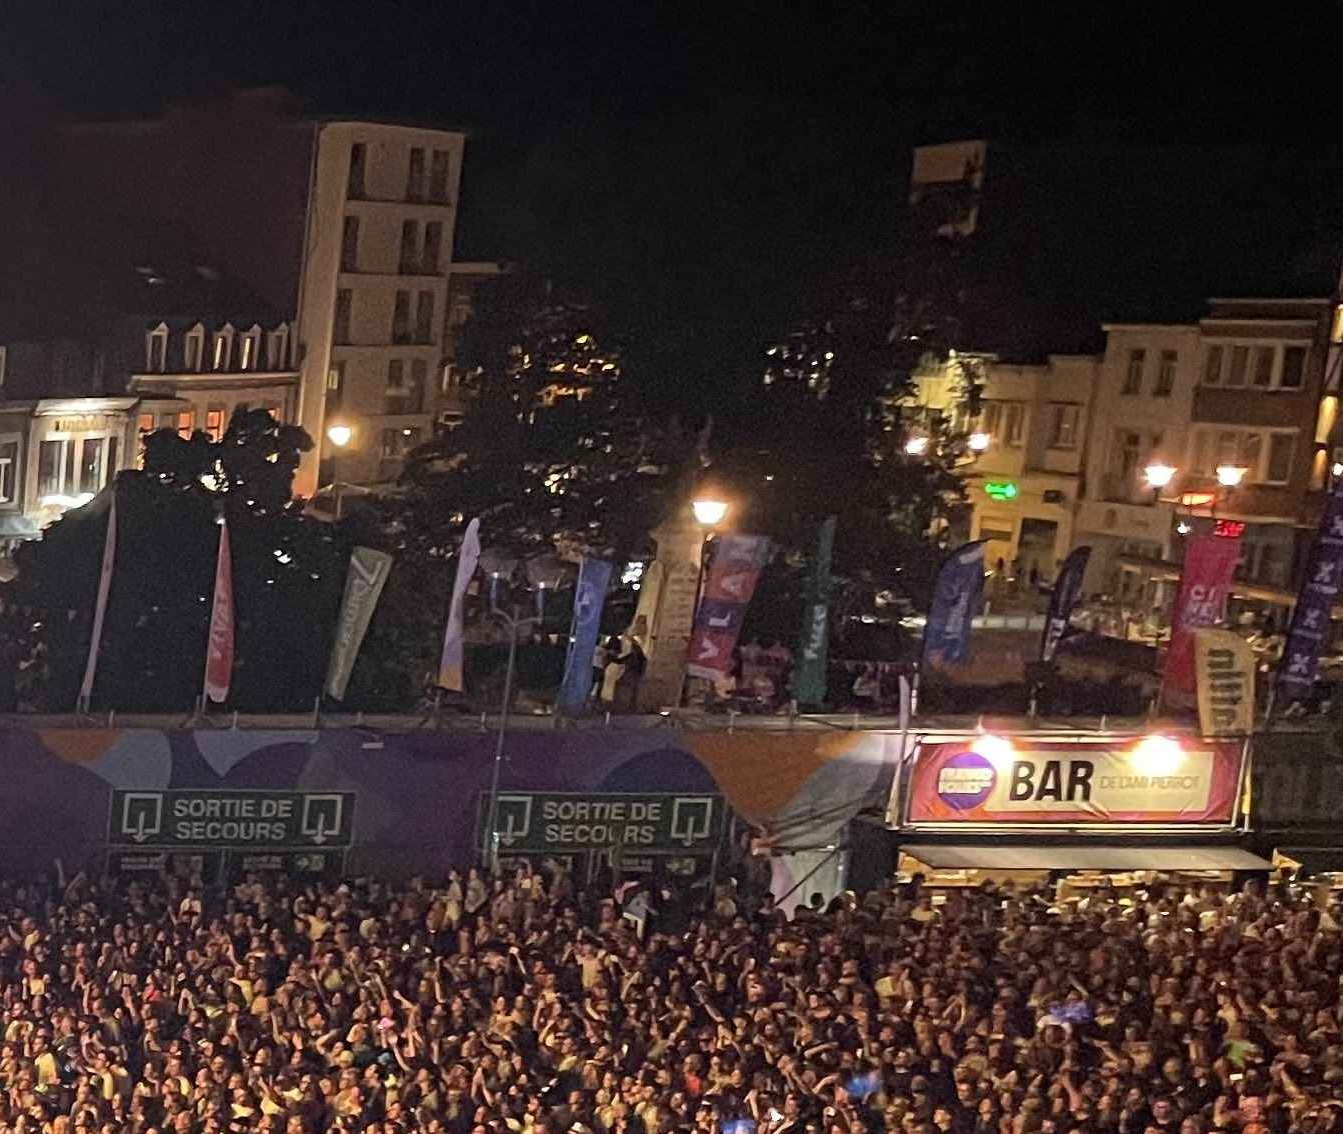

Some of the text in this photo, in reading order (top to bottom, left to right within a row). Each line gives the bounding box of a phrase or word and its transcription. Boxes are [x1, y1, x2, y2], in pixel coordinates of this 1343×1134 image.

[1009, 760, 1095, 801] BAR
[173, 799, 293, 817] SORTIE DE
[544, 801, 662, 821] SORTIE DE
[176, 821, 287, 840] SECOURS
